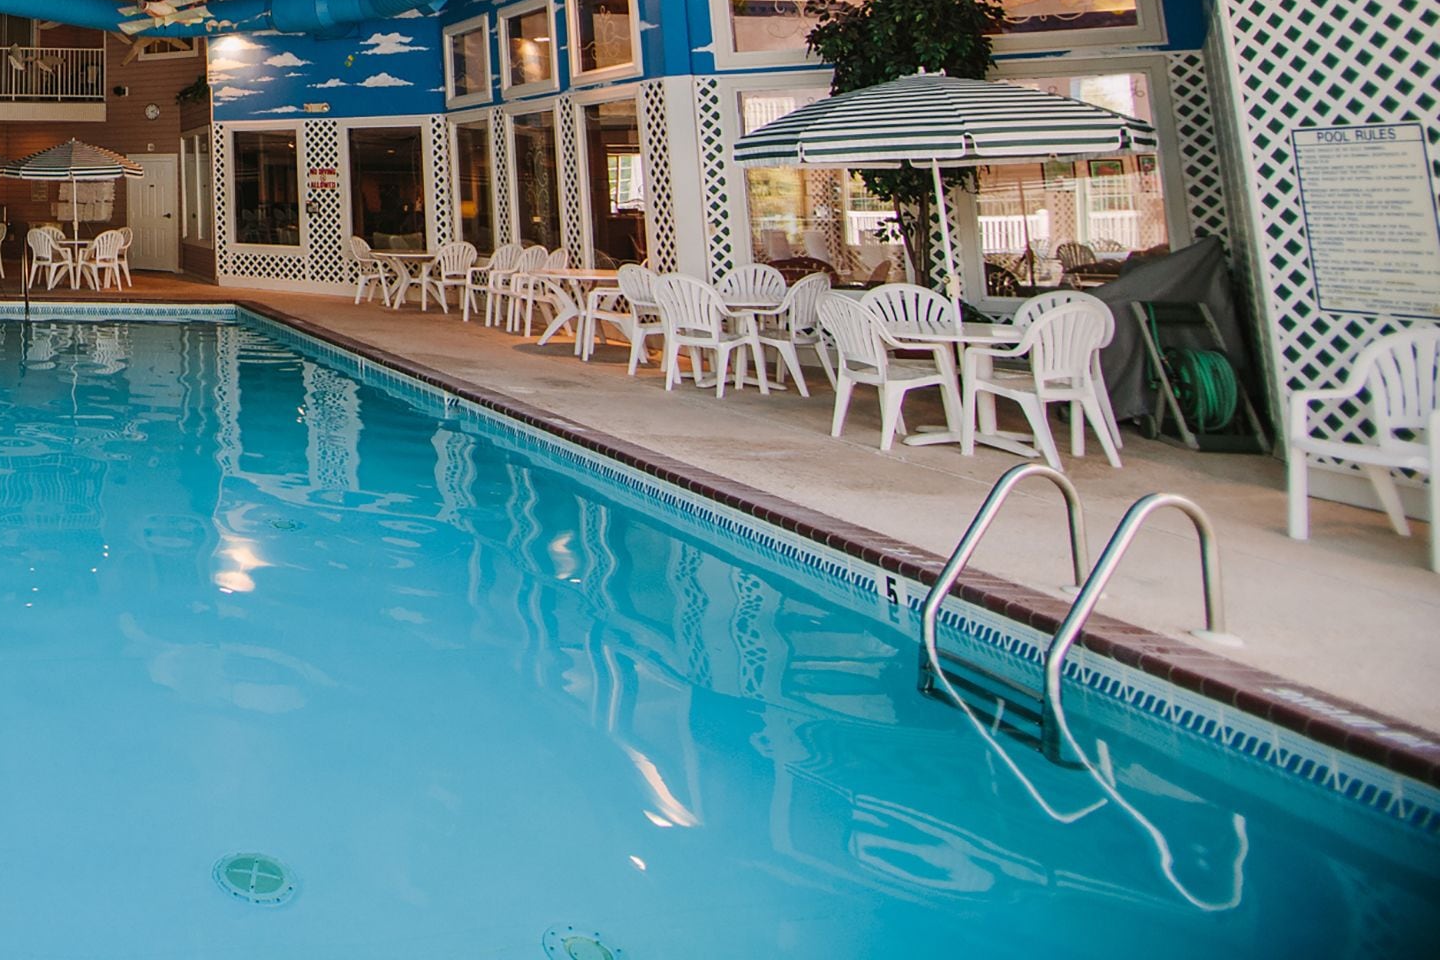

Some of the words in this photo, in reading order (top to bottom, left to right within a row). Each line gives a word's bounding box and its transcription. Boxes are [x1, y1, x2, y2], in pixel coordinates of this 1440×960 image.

[1317, 131, 1350, 142] POOL
[1355, 128, 1396, 140] RULES
[886, 576, 897, 605] 5
